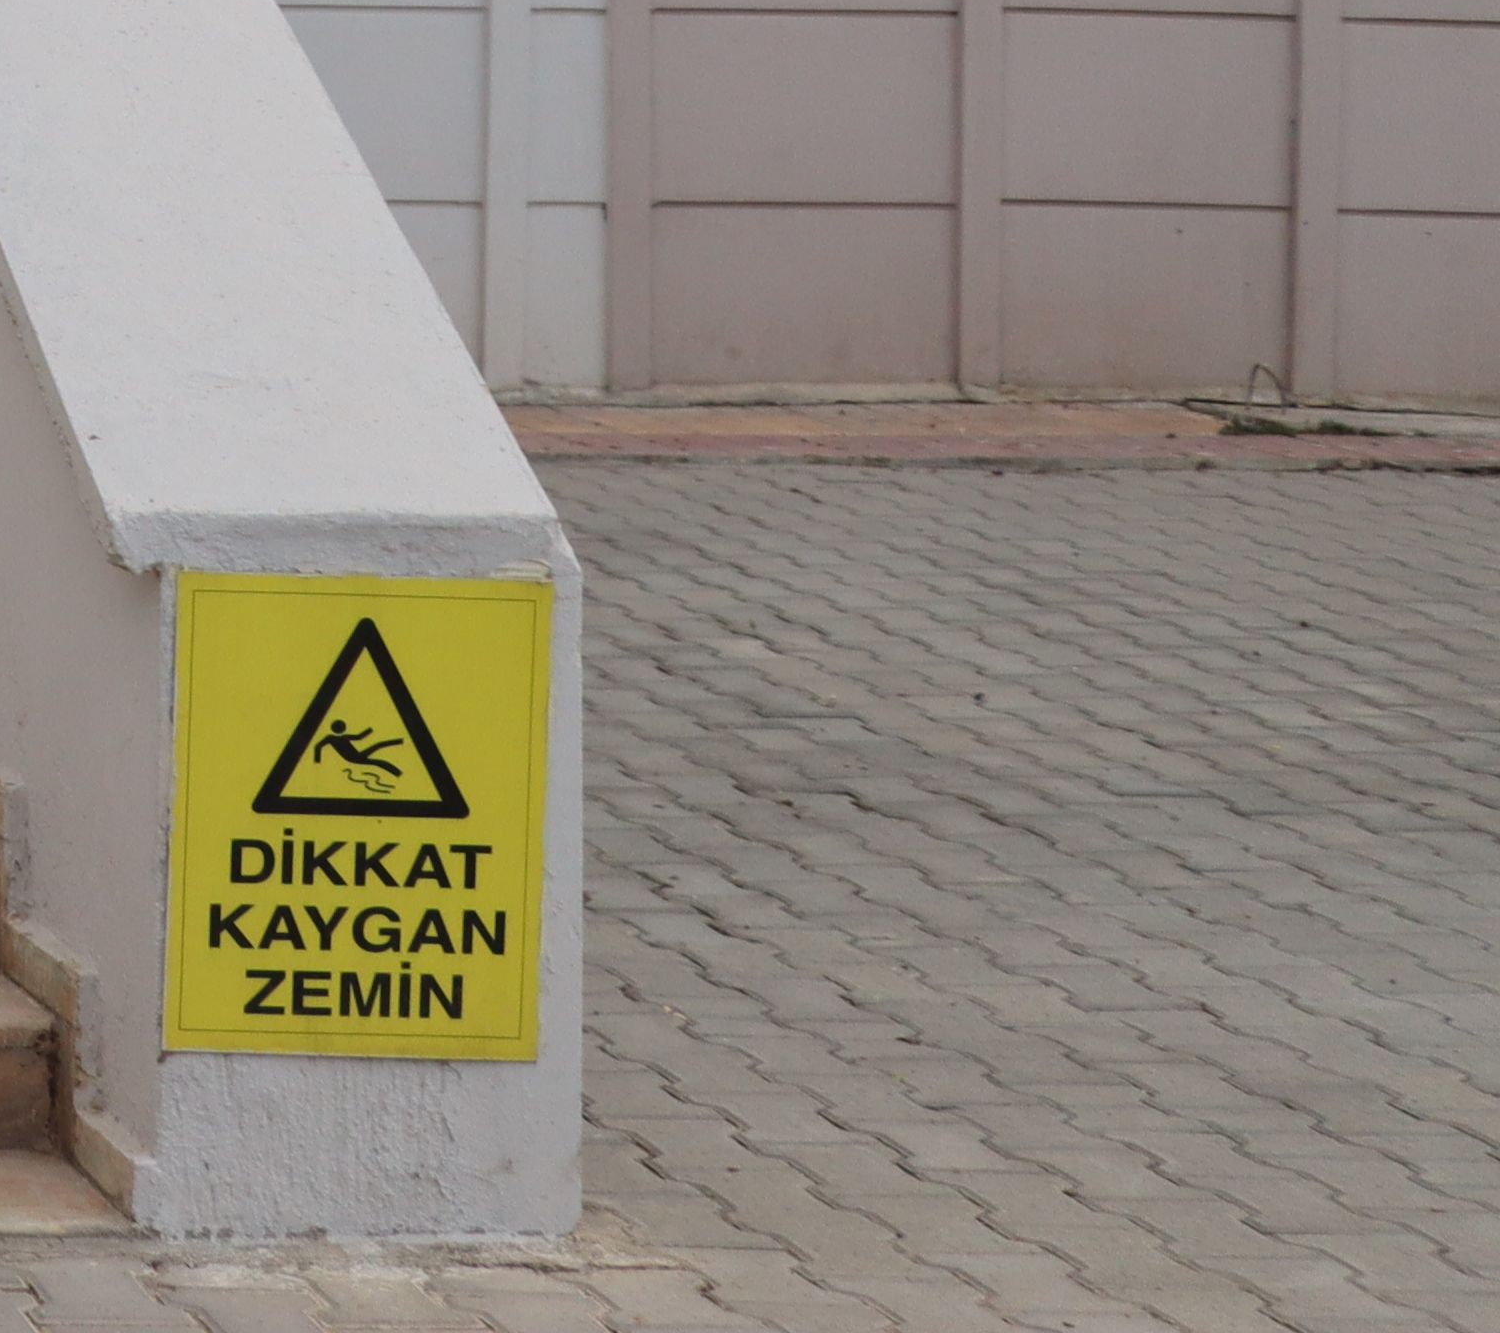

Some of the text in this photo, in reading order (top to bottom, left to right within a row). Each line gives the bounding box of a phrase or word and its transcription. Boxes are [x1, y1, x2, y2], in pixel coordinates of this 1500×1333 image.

[229, 827, 493, 890] DİKKAT
[208, 903, 507, 956] KAYGAN
[243, 961, 464, 1020] ZEMİN
